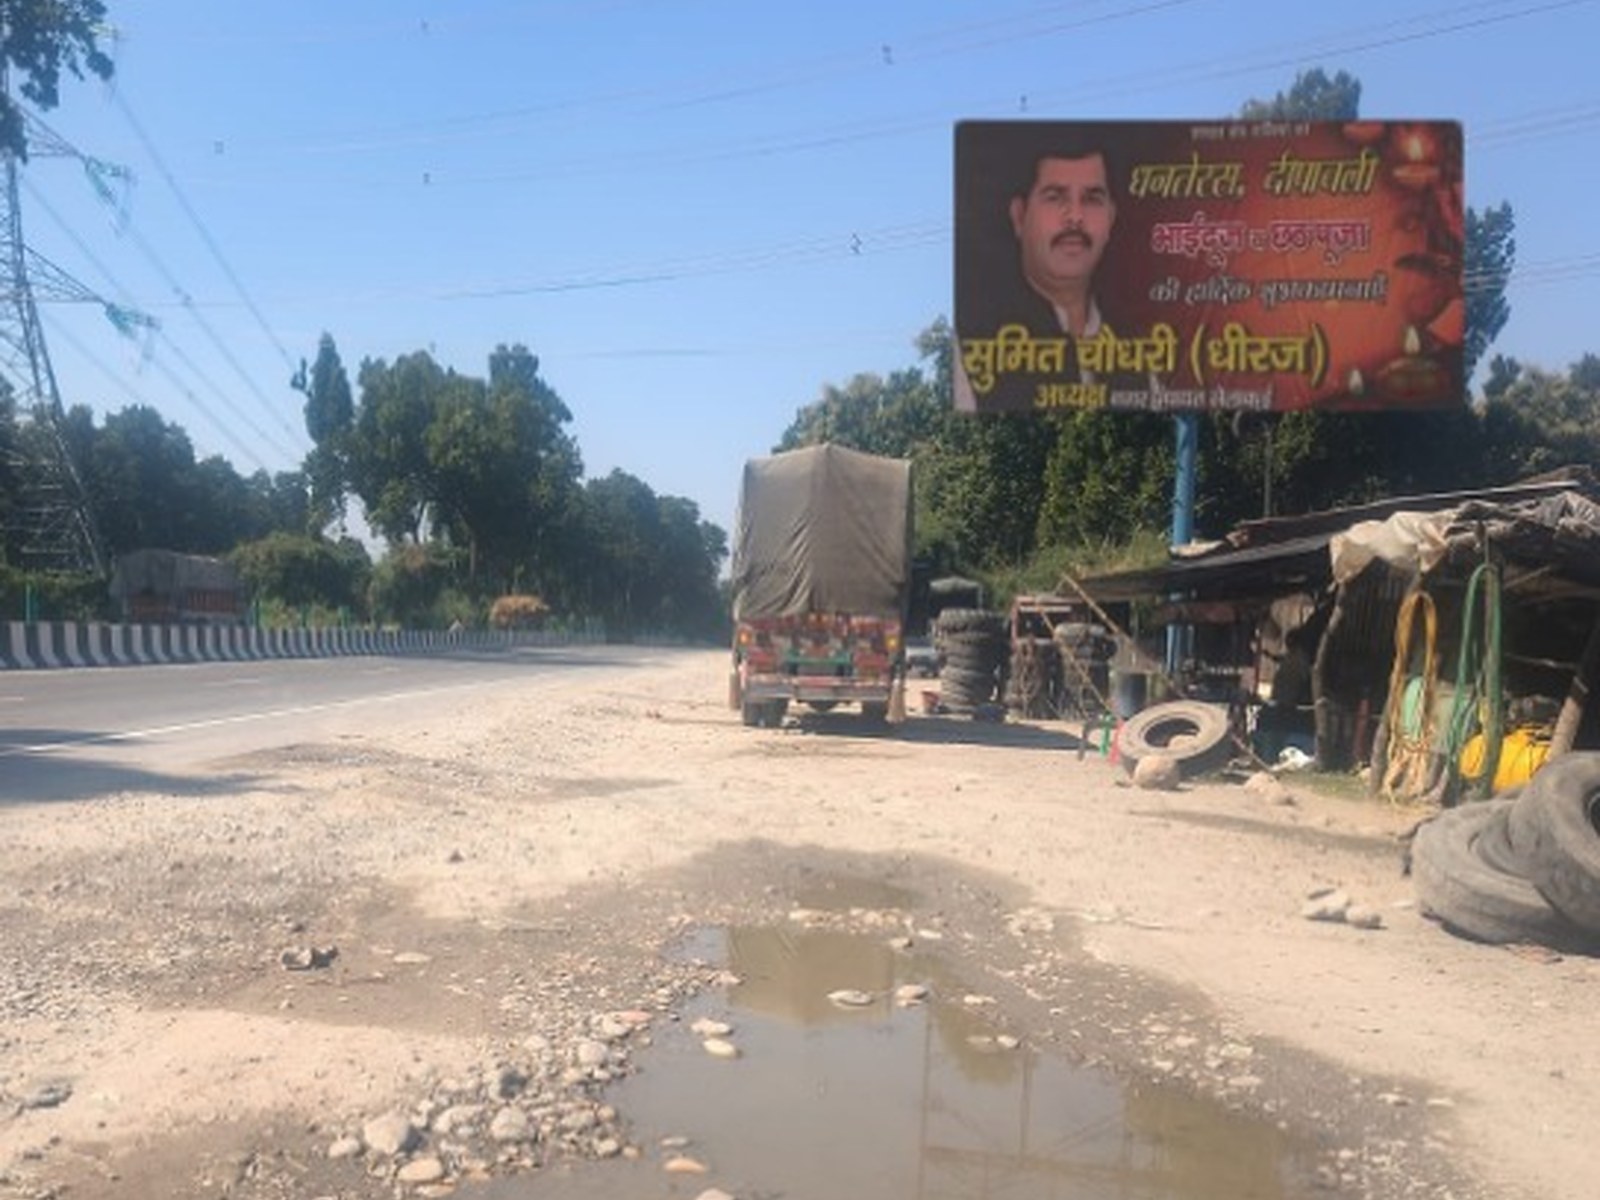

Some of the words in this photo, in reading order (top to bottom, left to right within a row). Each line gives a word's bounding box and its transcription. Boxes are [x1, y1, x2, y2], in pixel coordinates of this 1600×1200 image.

[1150, 276, 1180, 301] की
[1184, 276, 1251, 304] हार्दिक
[963, 325, 1066, 393] सुमित
[1190, 323, 1325, 388] (धीरज)
[1034, 382, 1107, 408] अध्यक्ष
